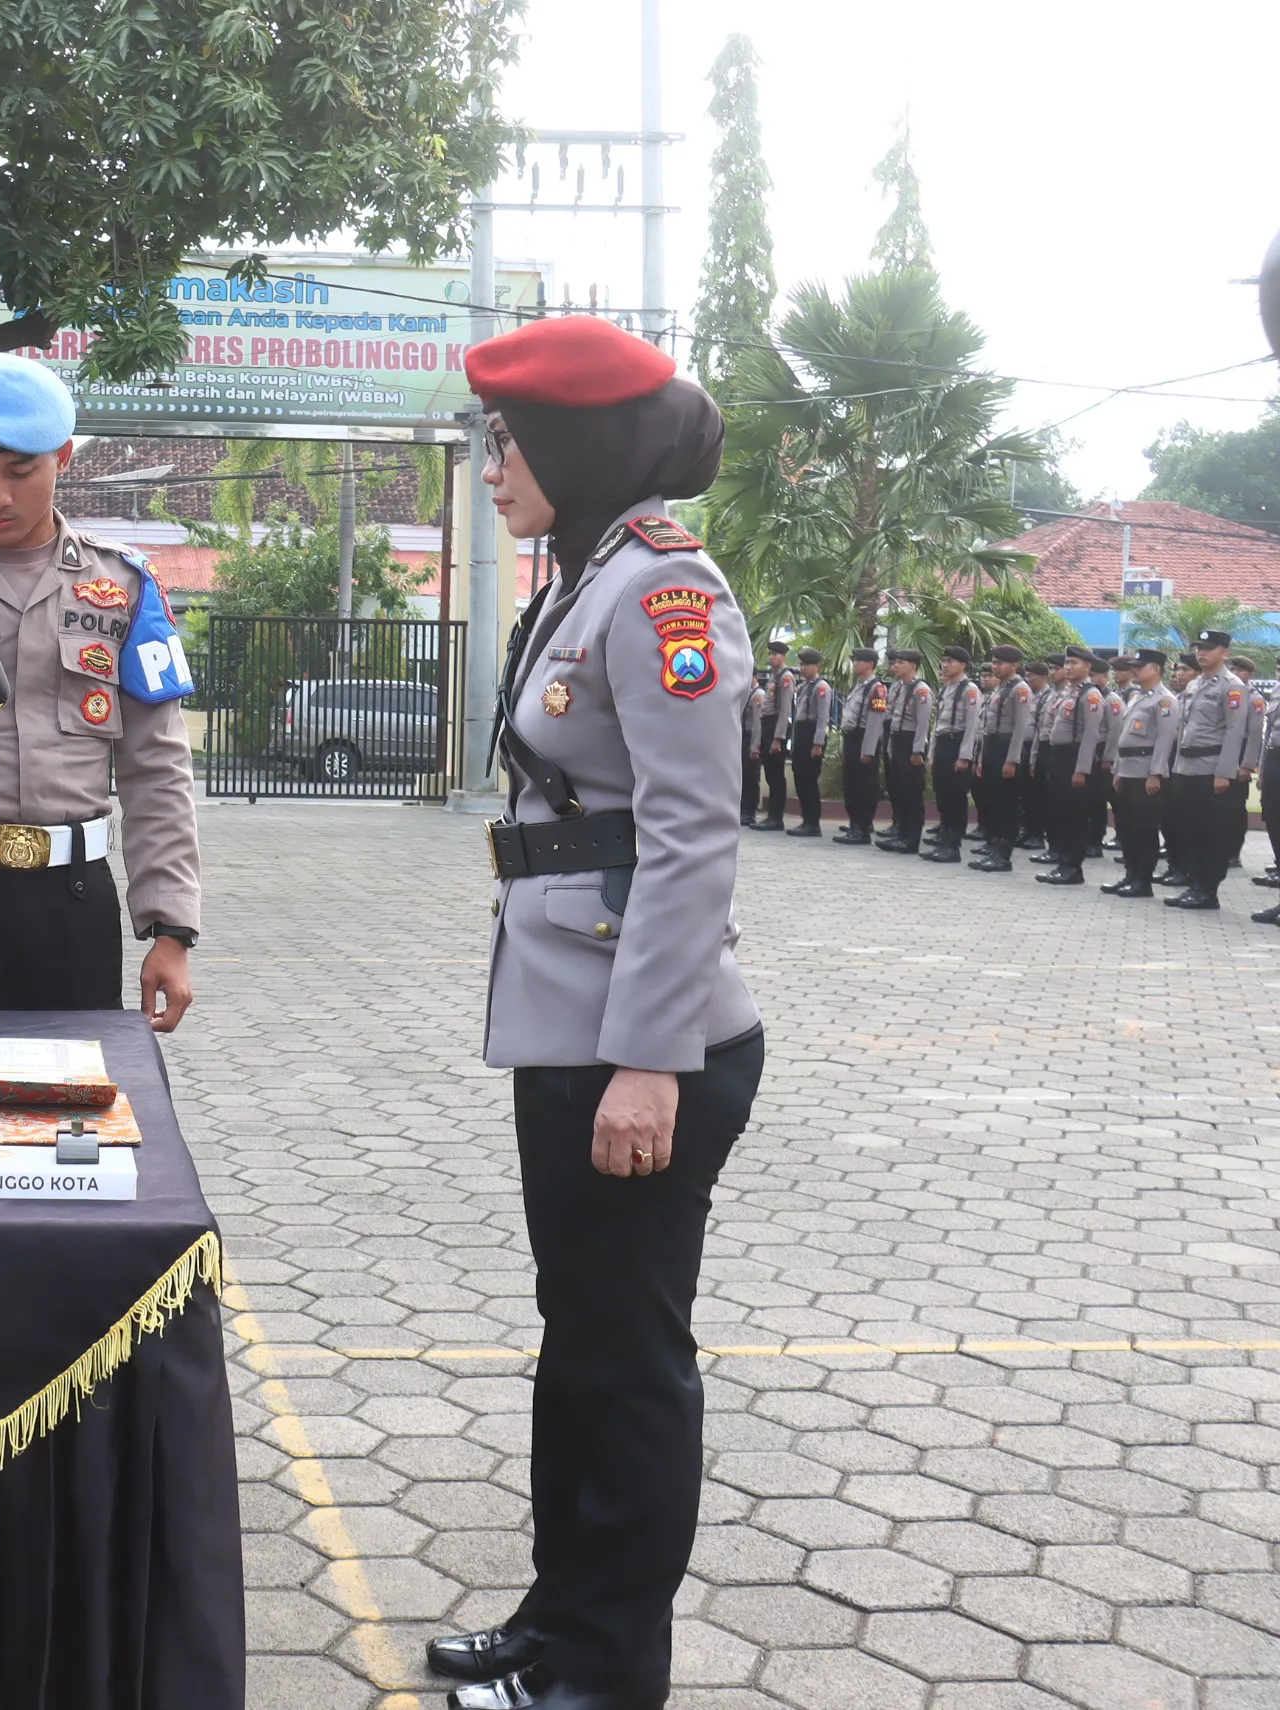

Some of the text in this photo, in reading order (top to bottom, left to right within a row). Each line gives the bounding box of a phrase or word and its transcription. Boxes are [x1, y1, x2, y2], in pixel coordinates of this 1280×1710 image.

[228, 309, 289, 328] Anda
[295, 311, 383, 333] Kepada
[389, 313, 447, 333] Kami
[251, 337, 438, 371] PROBOLINGGO
[184, 370, 235, 383] Bebas
[239, 372, 302, 388] Korupsi
[168, 385, 220, 399] Bersih
[225, 387, 255, 400] dan
[261, 389, 334, 404] Melayani
[338, 391, 405, 406] (WBBM)
[651, 590, 706, 605] POLRES
[661, 621, 705, 632] JAWA TIMUR
[50, 1176, 99, 1192] KOTA
